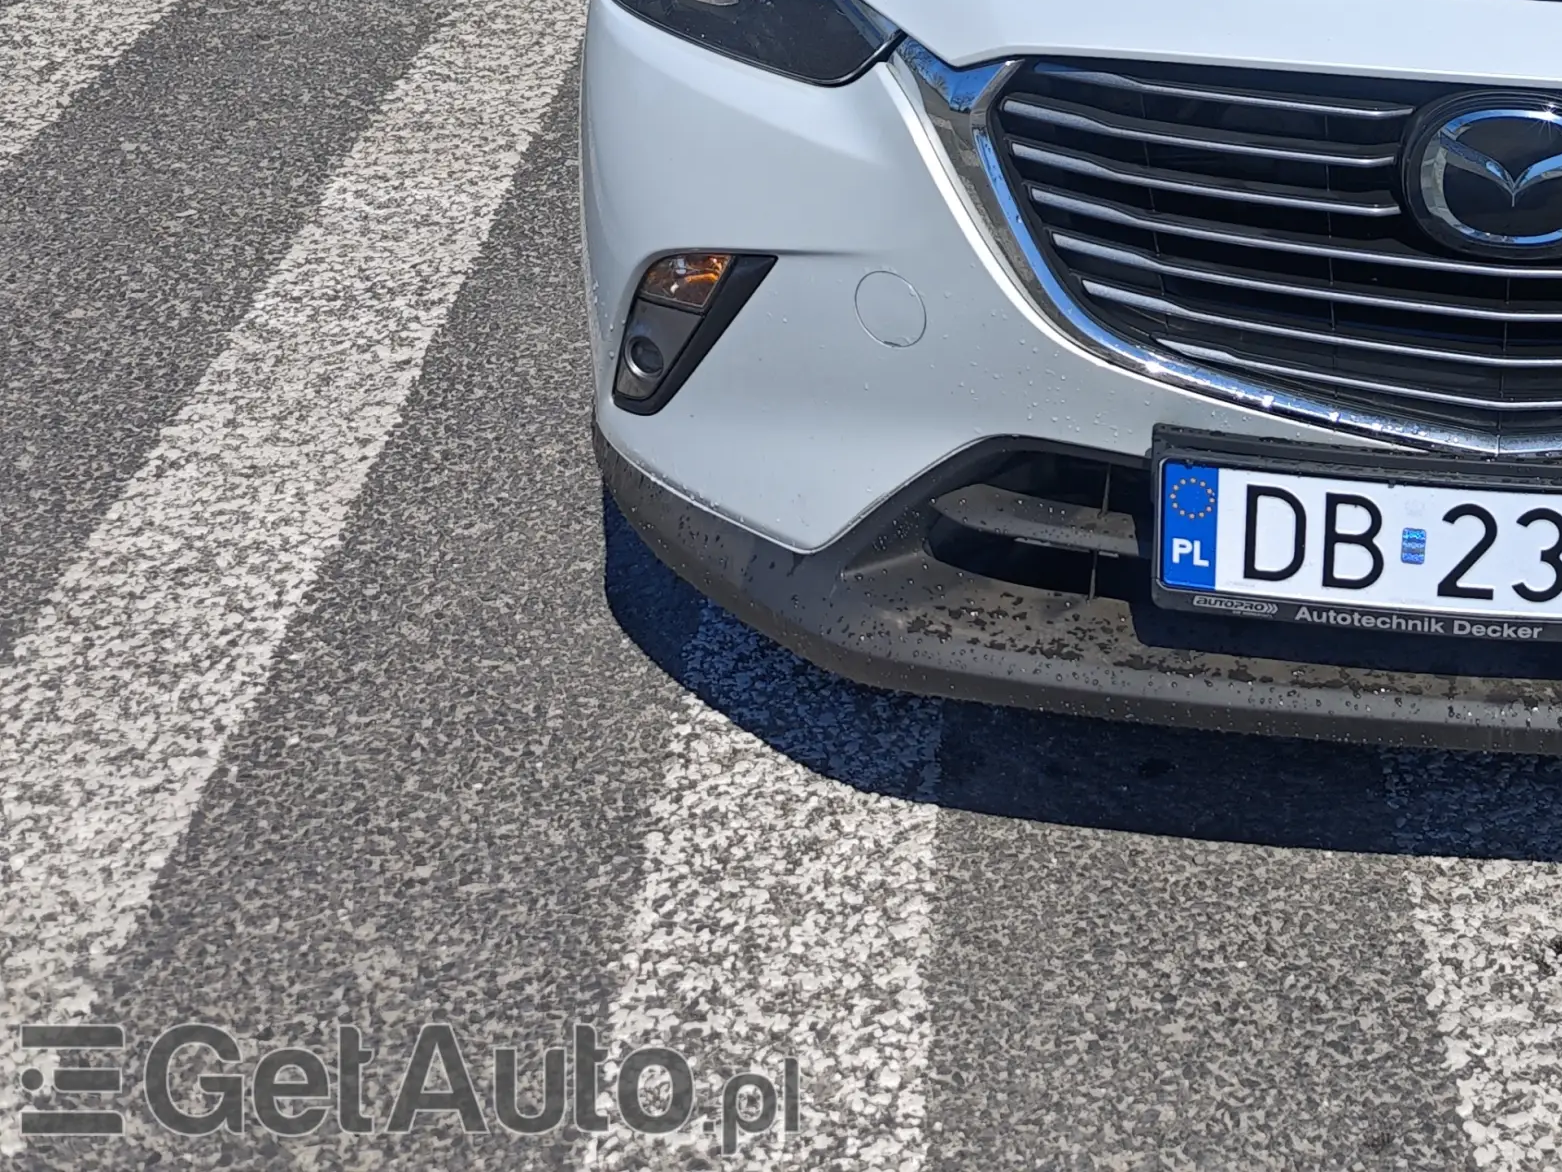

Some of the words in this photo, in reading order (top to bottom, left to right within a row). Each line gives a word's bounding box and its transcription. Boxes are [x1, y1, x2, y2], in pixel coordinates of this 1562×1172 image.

[1171, 537, 1210, 567] PL
[1242, 483, 1385, 590] DB
[1295, 606, 1446, 636] Autotechnik
[1453, 620, 1543, 640] Decker
